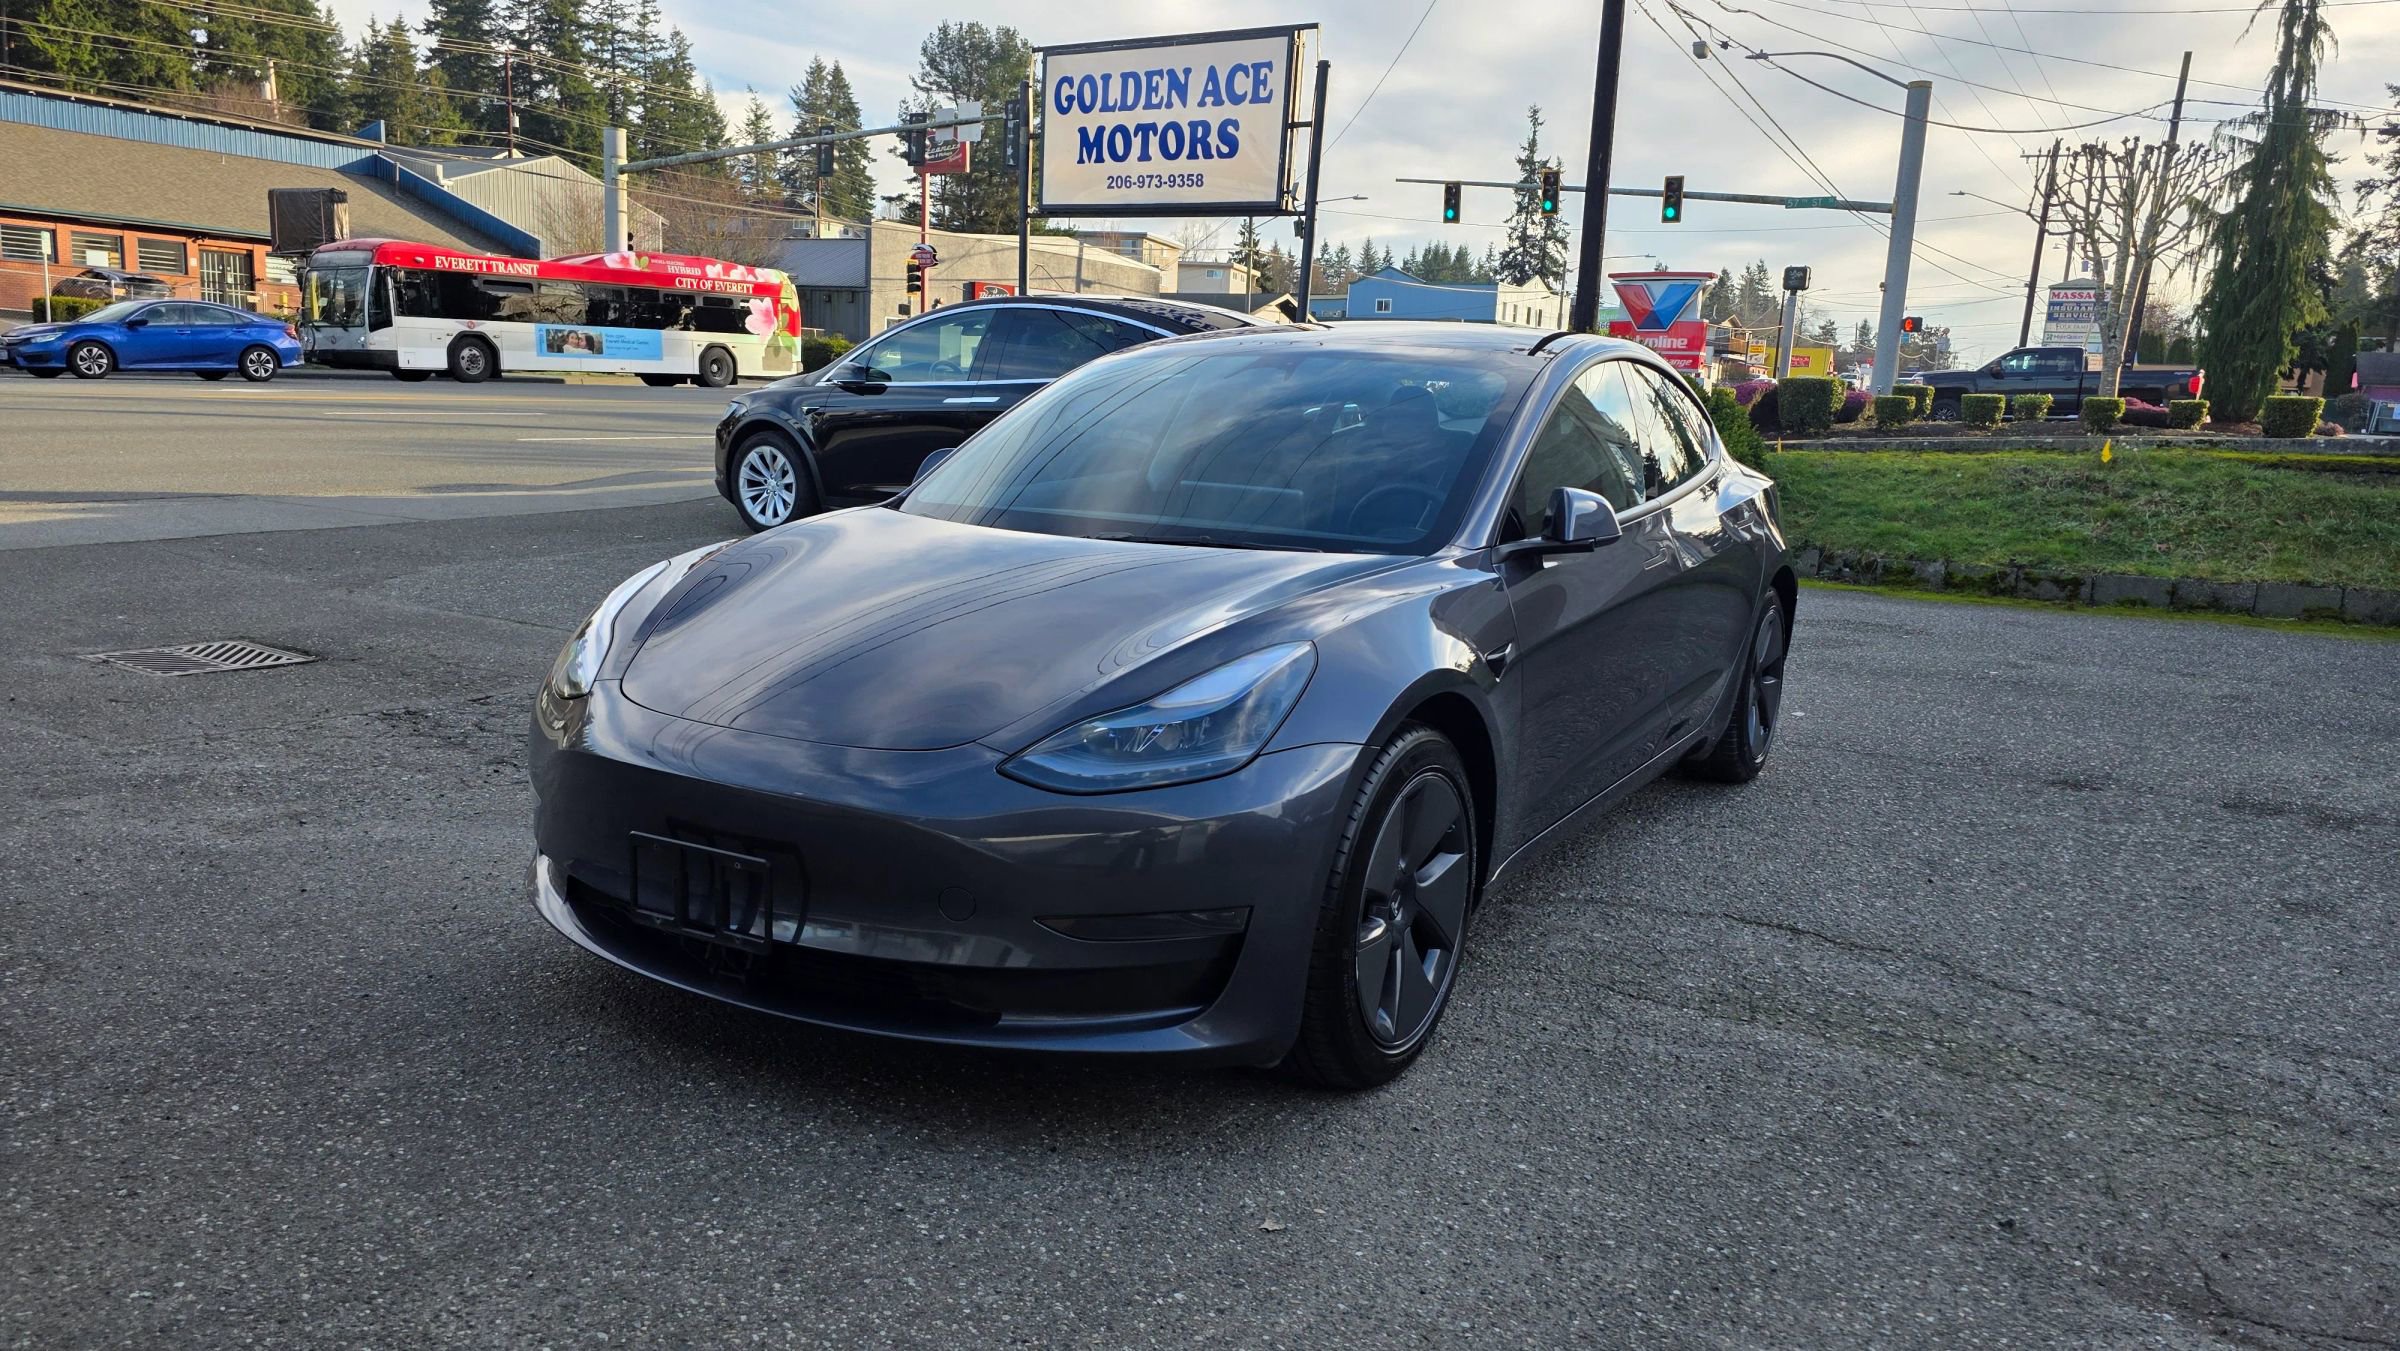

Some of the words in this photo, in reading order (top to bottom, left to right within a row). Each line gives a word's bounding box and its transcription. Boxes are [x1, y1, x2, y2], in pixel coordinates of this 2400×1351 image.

[1054, 67, 1192, 115] GOLDEN
[1197, 60, 1274, 107] ACE
[1076, 118, 1240, 164] MOTORS
[1106, 173, 1204, 189] 206-973-9358
[434, 255, 489, 272] EVERETT
[490, 261, 539, 276] TRANSIT
[667, 265, 702, 276] HYBRID
[675, 277, 699, 289] CITY
[700, 279, 713, 290] OF
[715, 281, 755, 294] EVERETT
